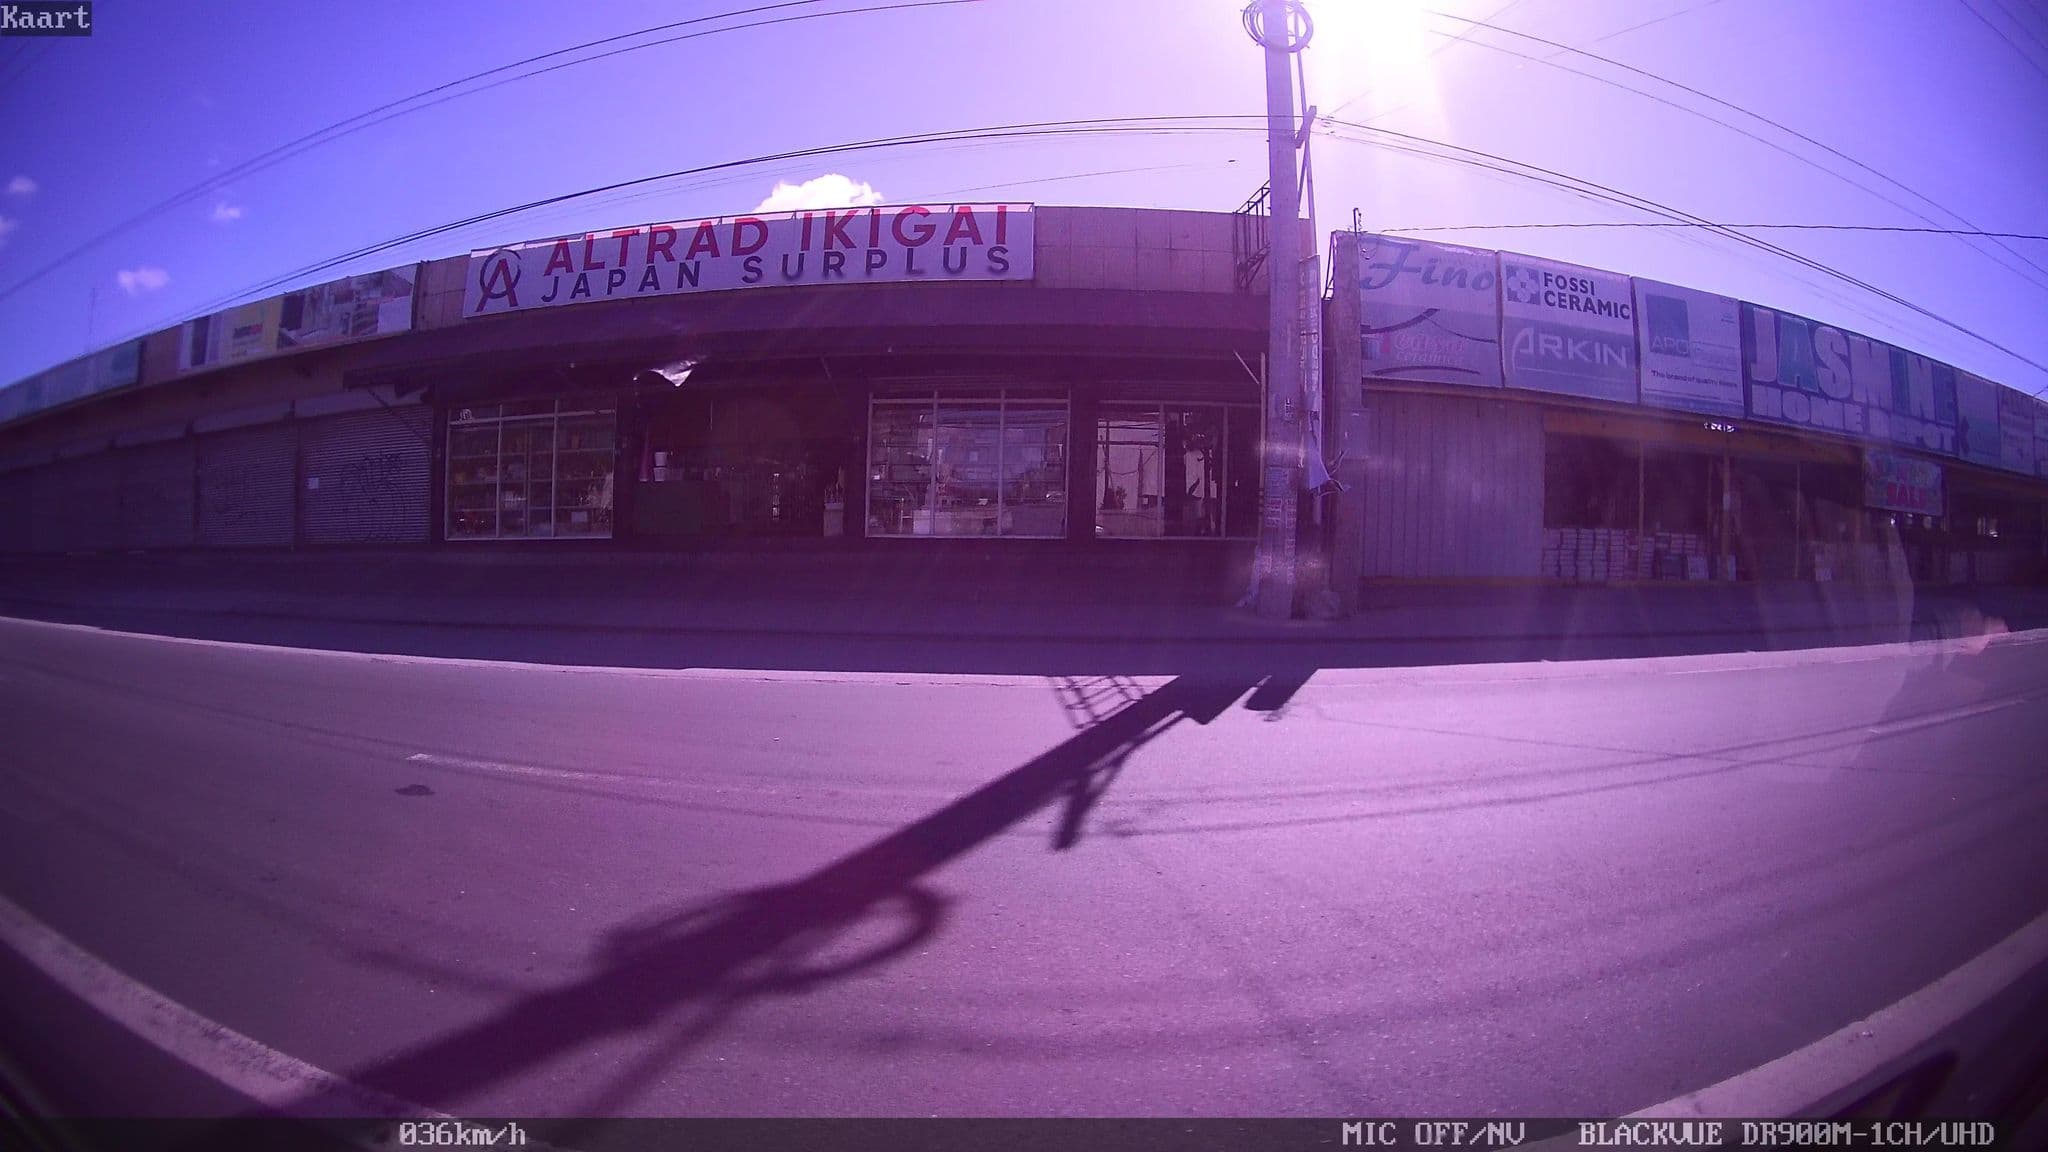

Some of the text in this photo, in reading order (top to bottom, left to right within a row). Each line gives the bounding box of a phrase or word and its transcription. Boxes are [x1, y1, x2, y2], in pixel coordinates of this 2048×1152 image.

[543, 205, 1007, 277] ALTRAD IKIGAI
[1360, 238, 1496, 291] Fino
[540, 245, 1010, 303] JAPAN SURPLUS
[1542, 271, 1596, 296] FOSSI
[1543, 290, 1632, 320] CERAMIC
[1511, 327, 1628, 371] ARKIN
[1751, 306, 1957, 427] JASMINE
[1751, 383, 1867, 434] HOME
